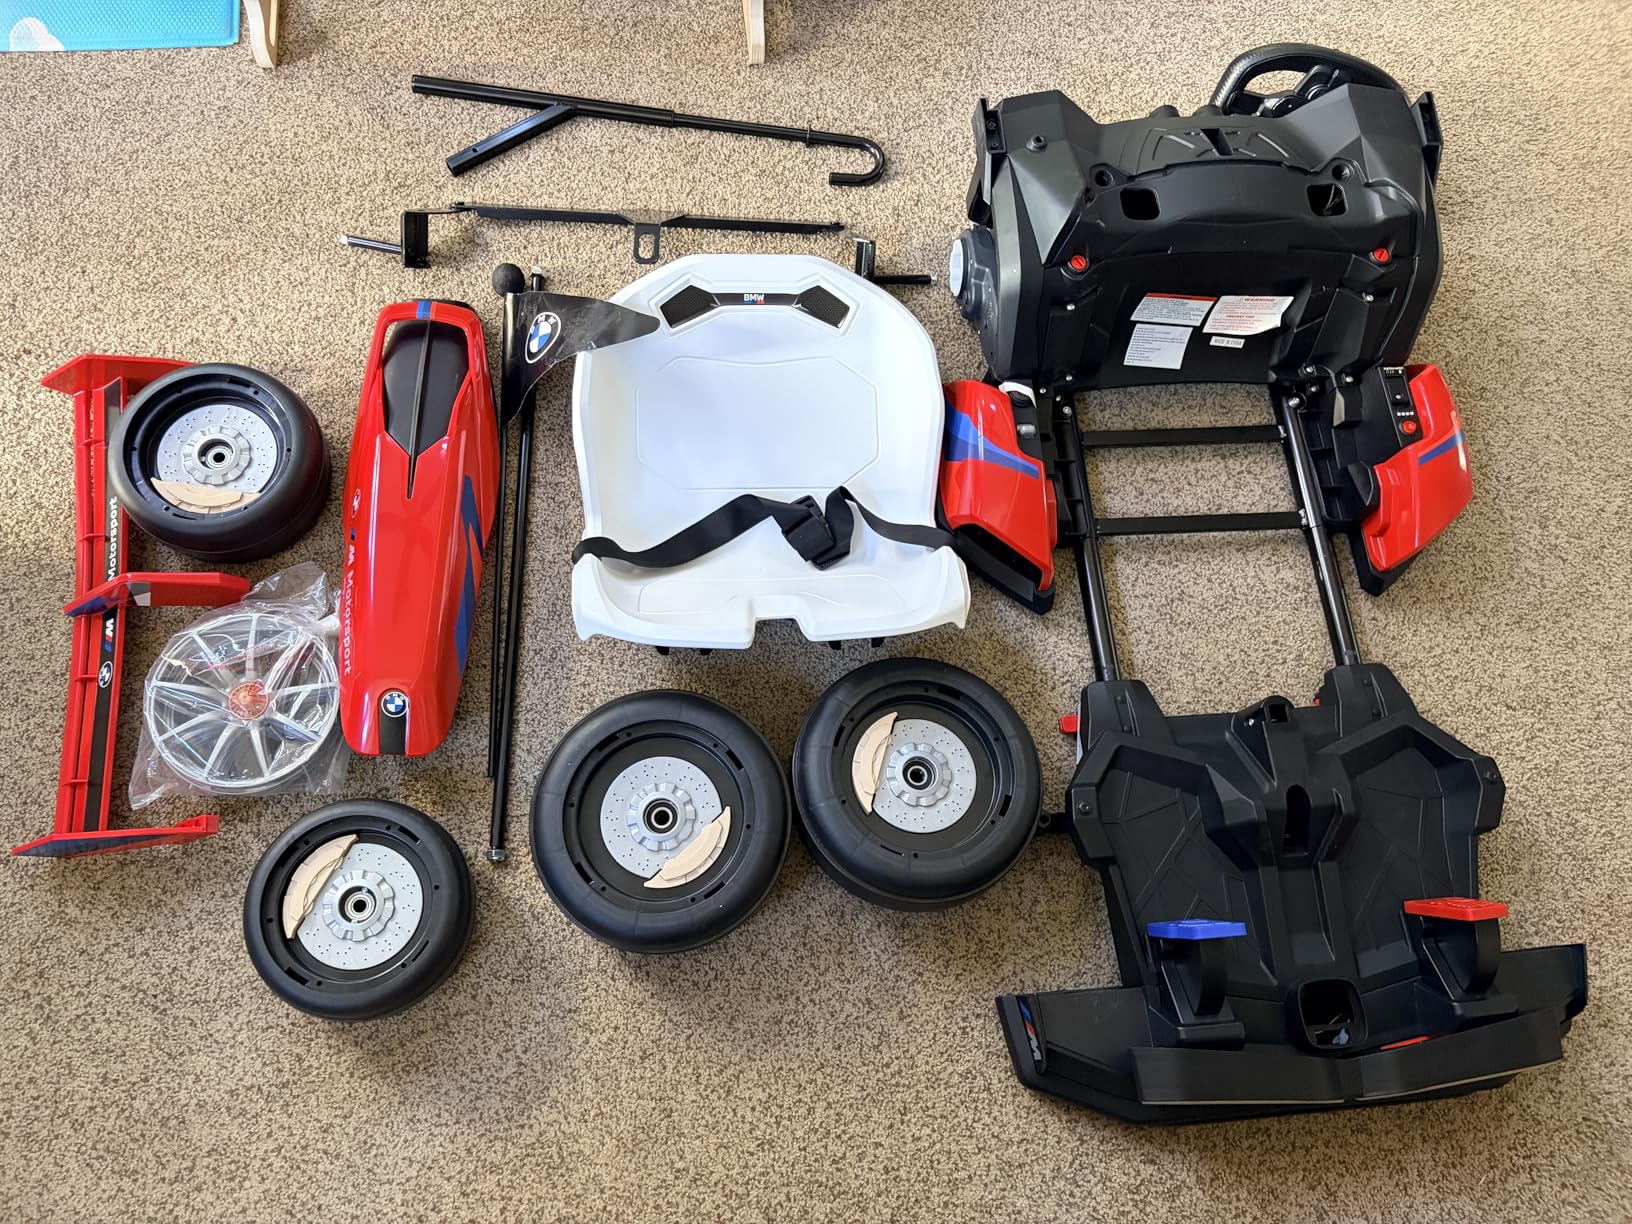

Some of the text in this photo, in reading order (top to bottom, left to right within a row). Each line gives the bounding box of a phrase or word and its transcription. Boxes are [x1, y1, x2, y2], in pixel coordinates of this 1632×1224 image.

[744, 293, 765, 301] BMW
[107, 496, 118, 581] Motorsport
[343, 569, 354, 677] Motorsport
